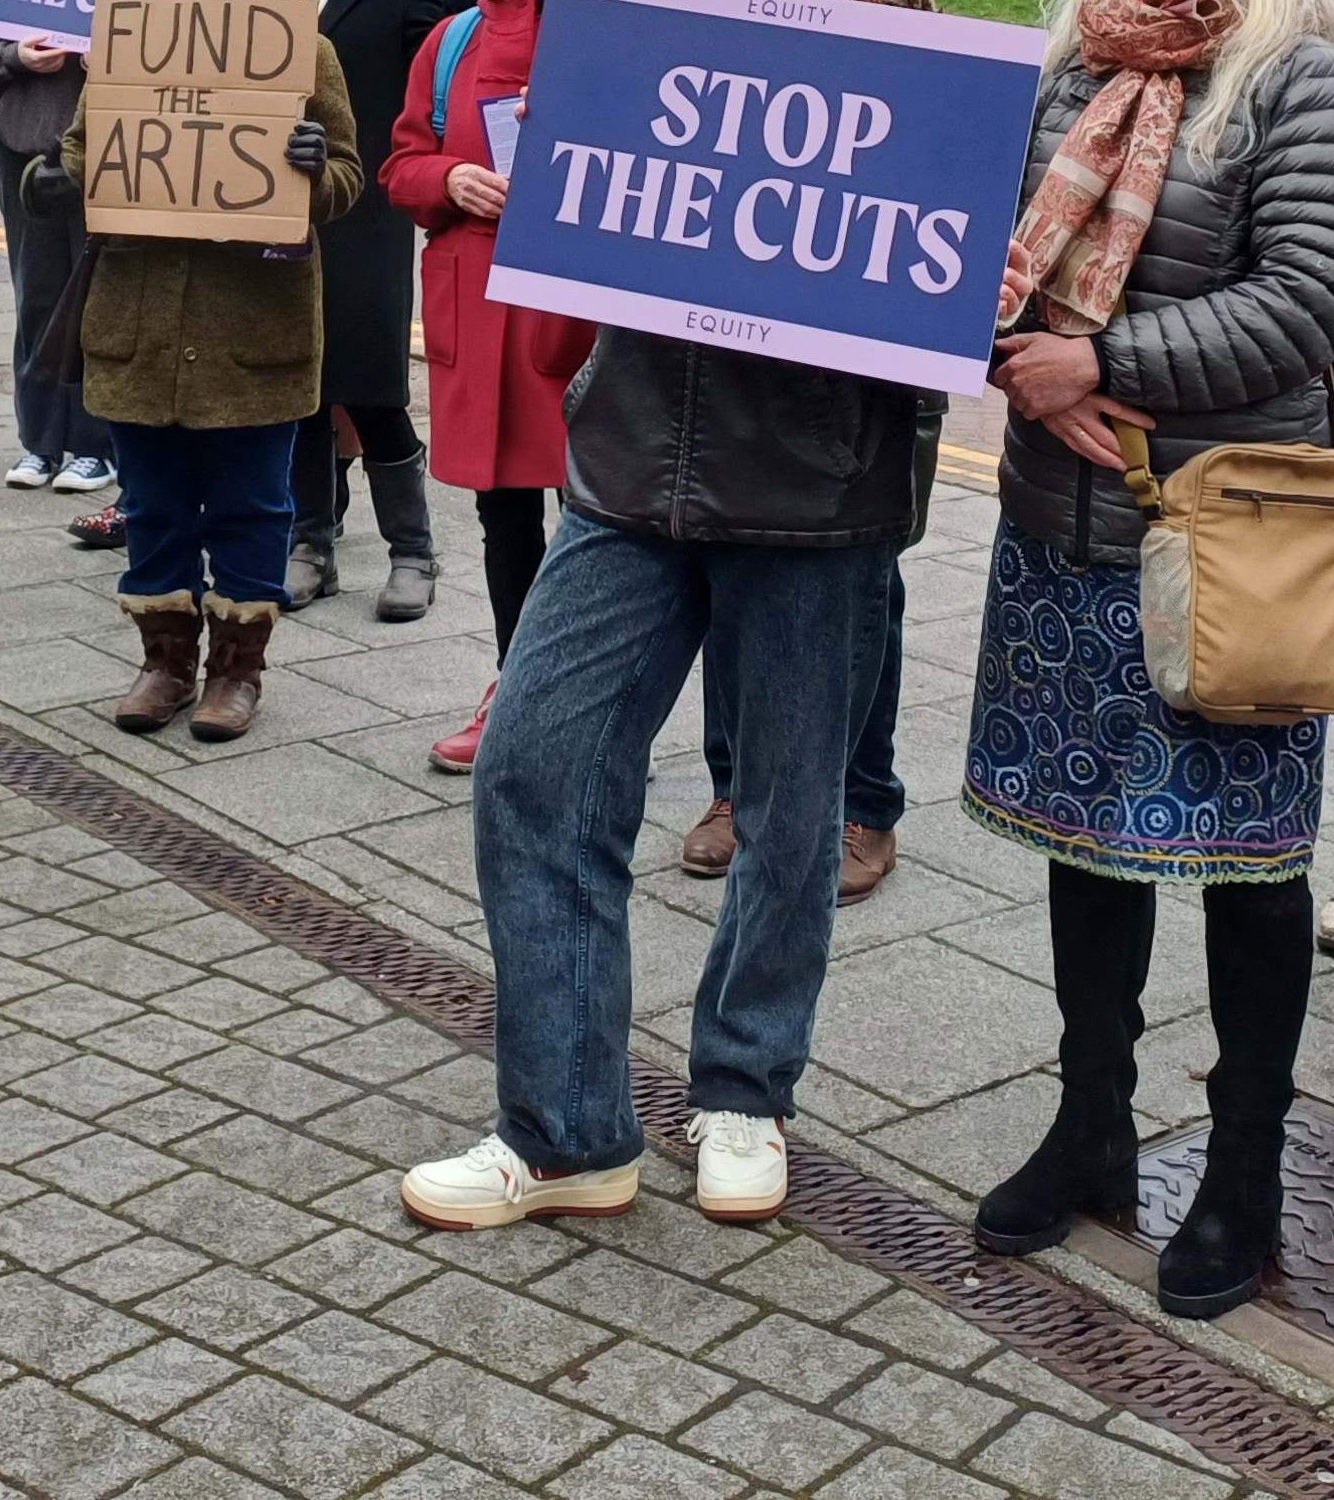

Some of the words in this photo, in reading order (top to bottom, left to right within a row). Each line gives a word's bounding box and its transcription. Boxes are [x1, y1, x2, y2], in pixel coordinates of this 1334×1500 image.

[106, 0, 294, 81] FUND
[153, 86, 212, 116] THE
[650, 65, 892, 176] STOP
[89, 118, 276, 211] ARTS
[550, 140, 724, 250] THE
[733, 177, 970, 294] CUTS
[686, 311, 772, 343] EQUITY
